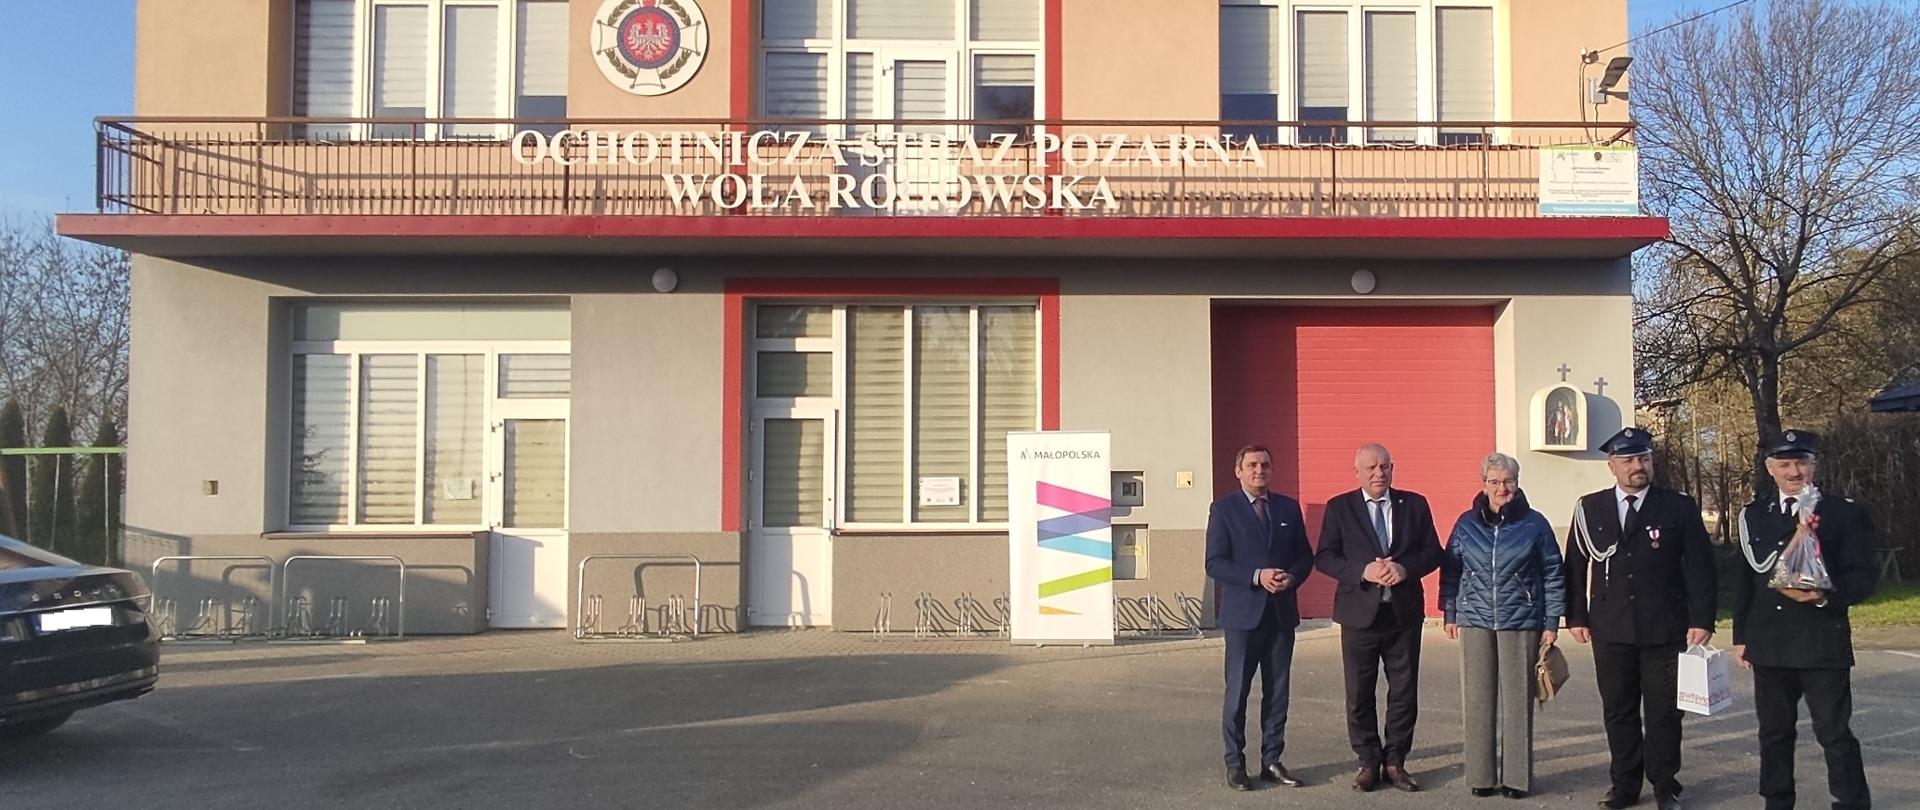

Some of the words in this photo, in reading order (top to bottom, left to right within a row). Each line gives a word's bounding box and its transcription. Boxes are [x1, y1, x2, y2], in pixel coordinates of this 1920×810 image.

[511, 129, 849, 166] OCHOTNICZA
[662, 172, 815, 209] WOLA
[1033, 450, 1101, 460] MAŁOPOLSKA
